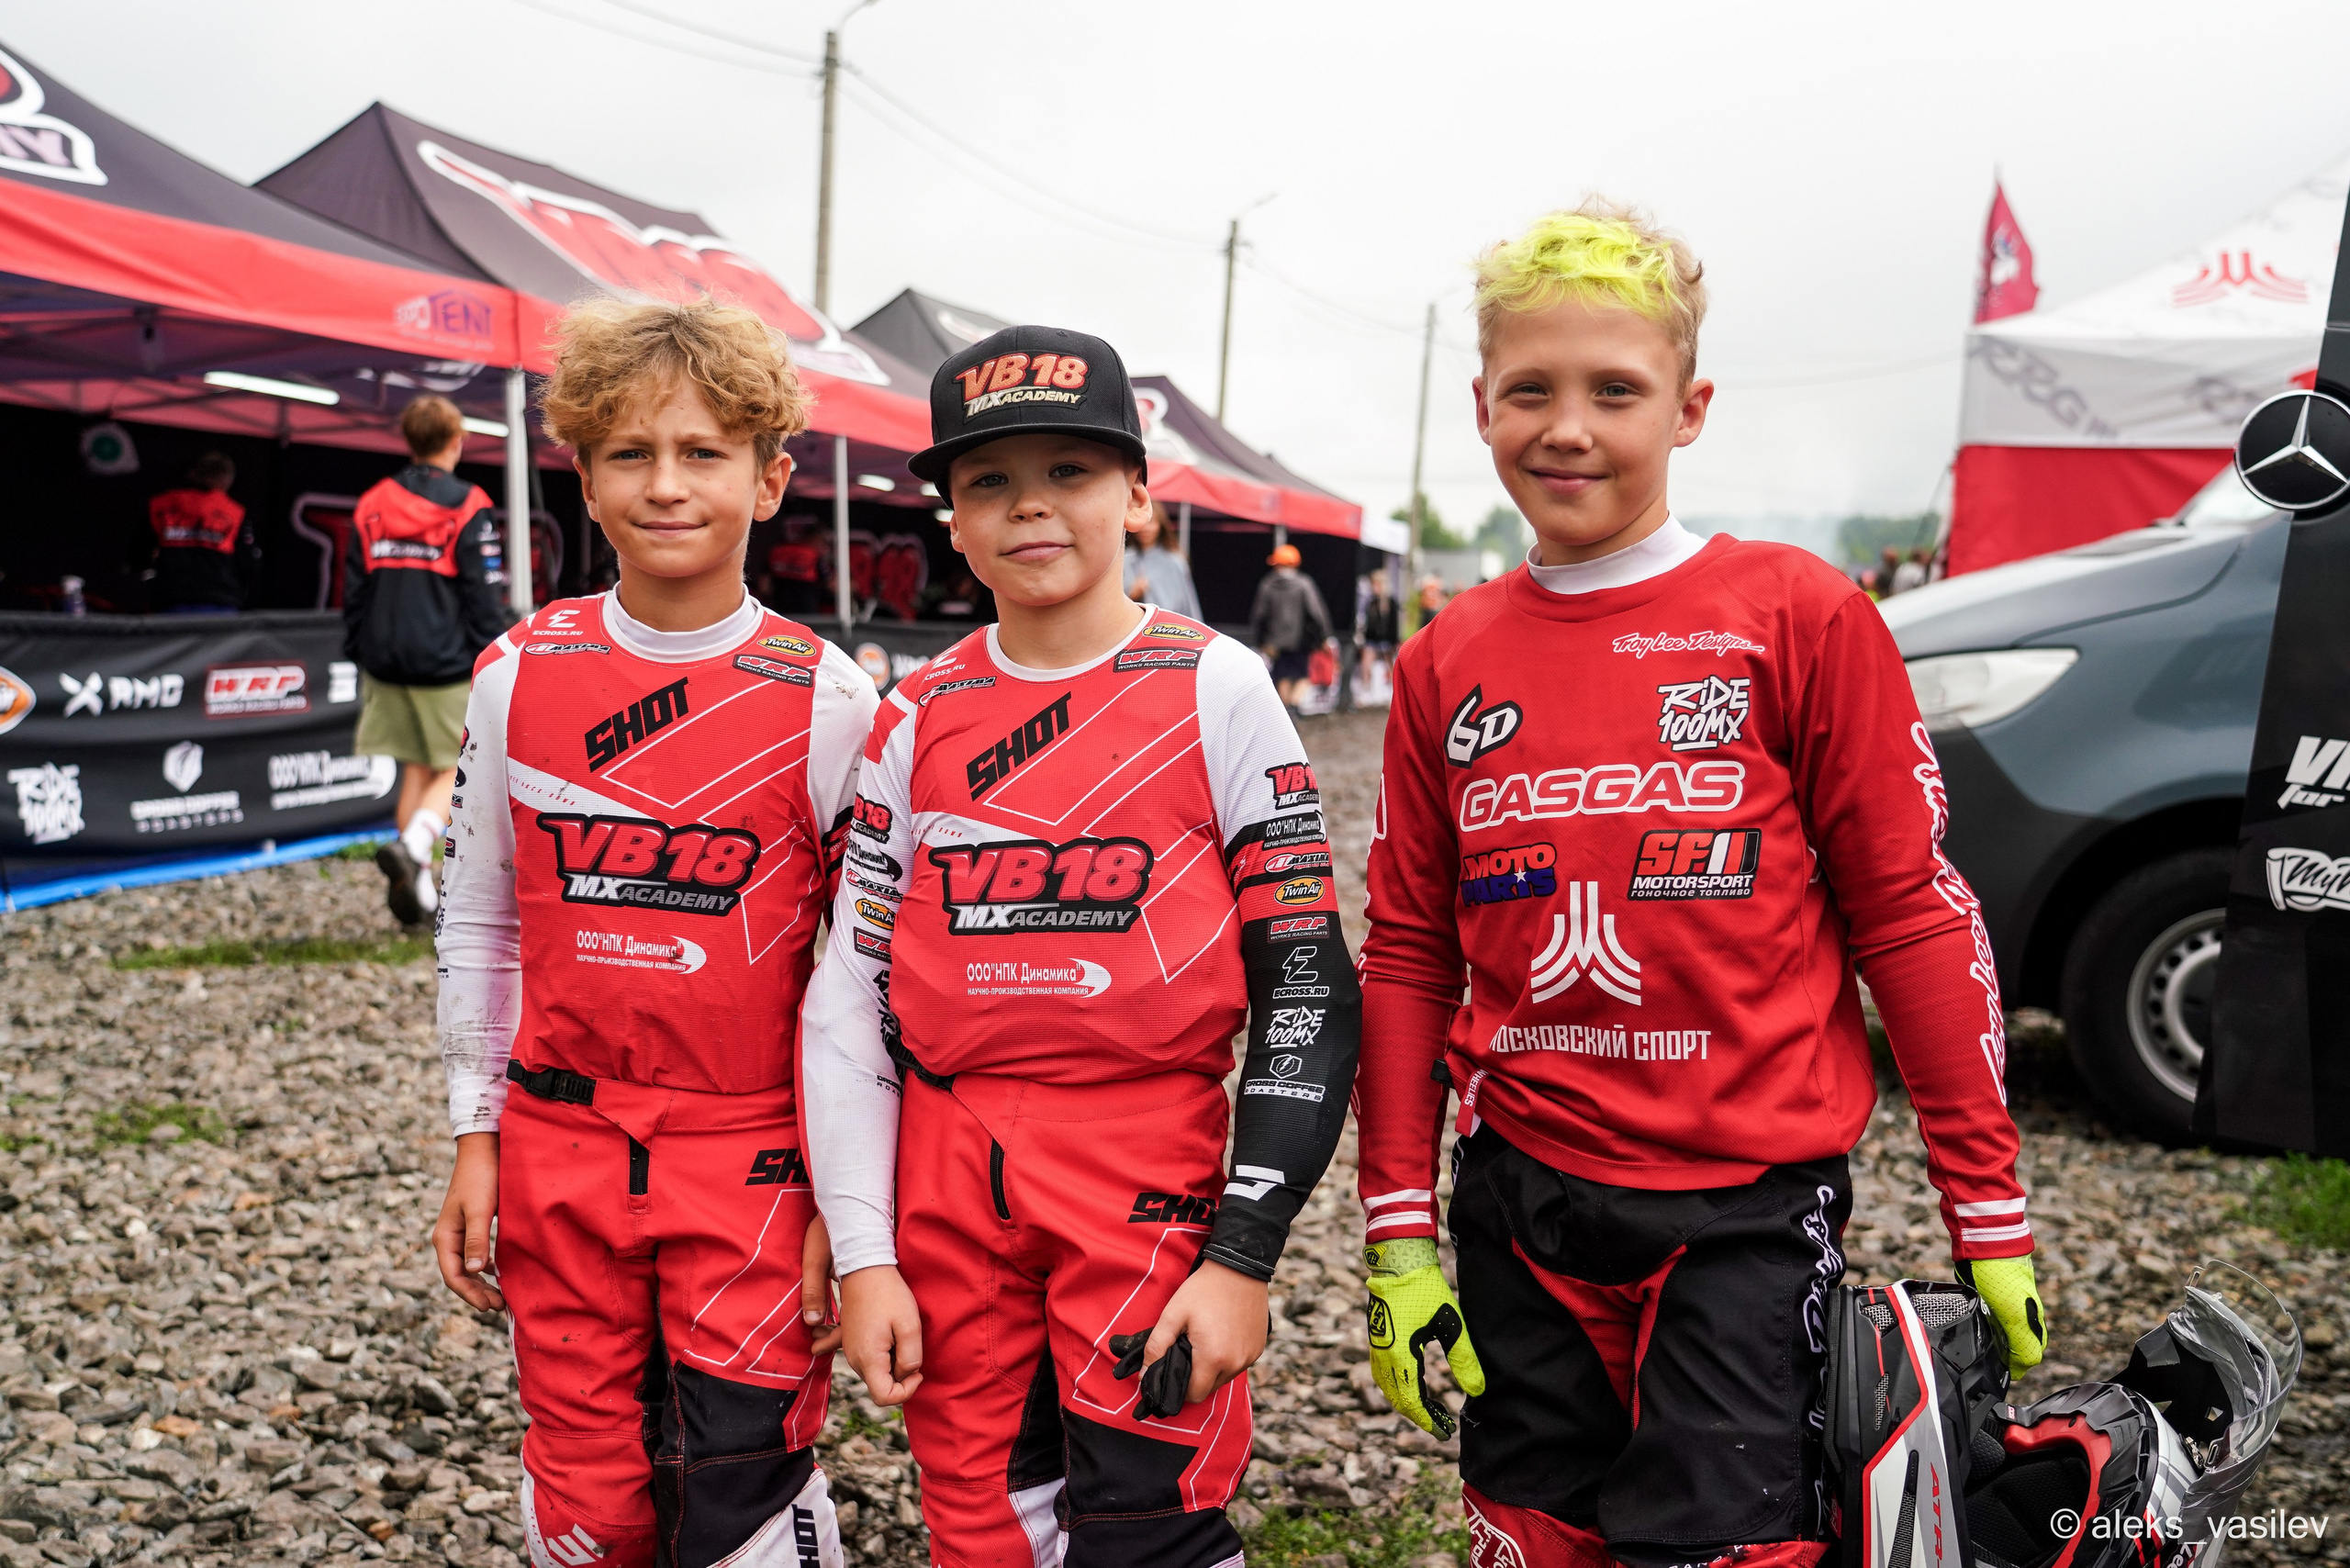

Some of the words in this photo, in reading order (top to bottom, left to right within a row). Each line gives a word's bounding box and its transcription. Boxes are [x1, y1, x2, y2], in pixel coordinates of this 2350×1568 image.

[955, 352, 1089, 401] VB18
[767, 637, 792, 649] Twin
[791, 642, 811, 653] Air
[1152, 625, 1180, 635] Twin
[1179, 628, 1199, 638] Air
[1612, 632, 1653, 659] Troy
[1652, 632, 1688, 652] Lee
[1687, 631, 1765, 657] Designs
[737, 655, 811, 678] WRP
[1118, 649, 1198, 665] WRP
[737, 663, 761, 673] WORKS
[762, 669, 787, 680] RACING
[787, 676, 810, 685] PARTS
[923, 664, 966, 681] CROSS.RU
[584, 677, 689, 773] SHOT
[1448, 695, 1517, 762] 6D
[1658, 708, 1748, 747] 100MX
[967, 690, 1072, 802] SHOT
[1268, 766, 1319, 795] VB1
[1460, 761, 1745, 833] GASGAS
[2277, 783, 2346, 810] for
[854, 795, 890, 831] B18
[542, 818, 756, 887] VB18
[1464, 844, 1556, 880] MOTO
[934, 843, 1148, 903] VB18
[1632, 875, 1753, 890] MOTORSPORT
[1284, 885, 1308, 898] Twin
[1308, 881, 1322, 894] Air
[1461, 868, 1557, 907] PARTS
[862, 902, 884, 917] Twin
[1270, 917, 1327, 935] WRP
[576, 955, 655, 969] НАУЧНО-ПРОИЗВОДСТВЕННАЯ
[655, 961, 687, 971] КОМПАНИЯ
[968, 987, 1053, 997] НАУЧНО-ПРОИЗВОДСТВЕННАЯ
[1054, 987, 1089, 995] КОМПАНИЯ
[1273, 987, 1329, 999] ECROSS.RU
[1265, 1025, 1320, 1047] 100MX
[1633, 1030, 1712, 1061] СПОРТ
[1245, 1088, 1322, 1101] ROASTERS
[1277, 1081, 1324, 1094] COFFEE
[1464, 1069, 1489, 1107] WHEELIES
[744, 1148, 810, 1186] SH
[1127, 1193, 1219, 1225] SHO
[790, 1504, 821, 1568] HOT
